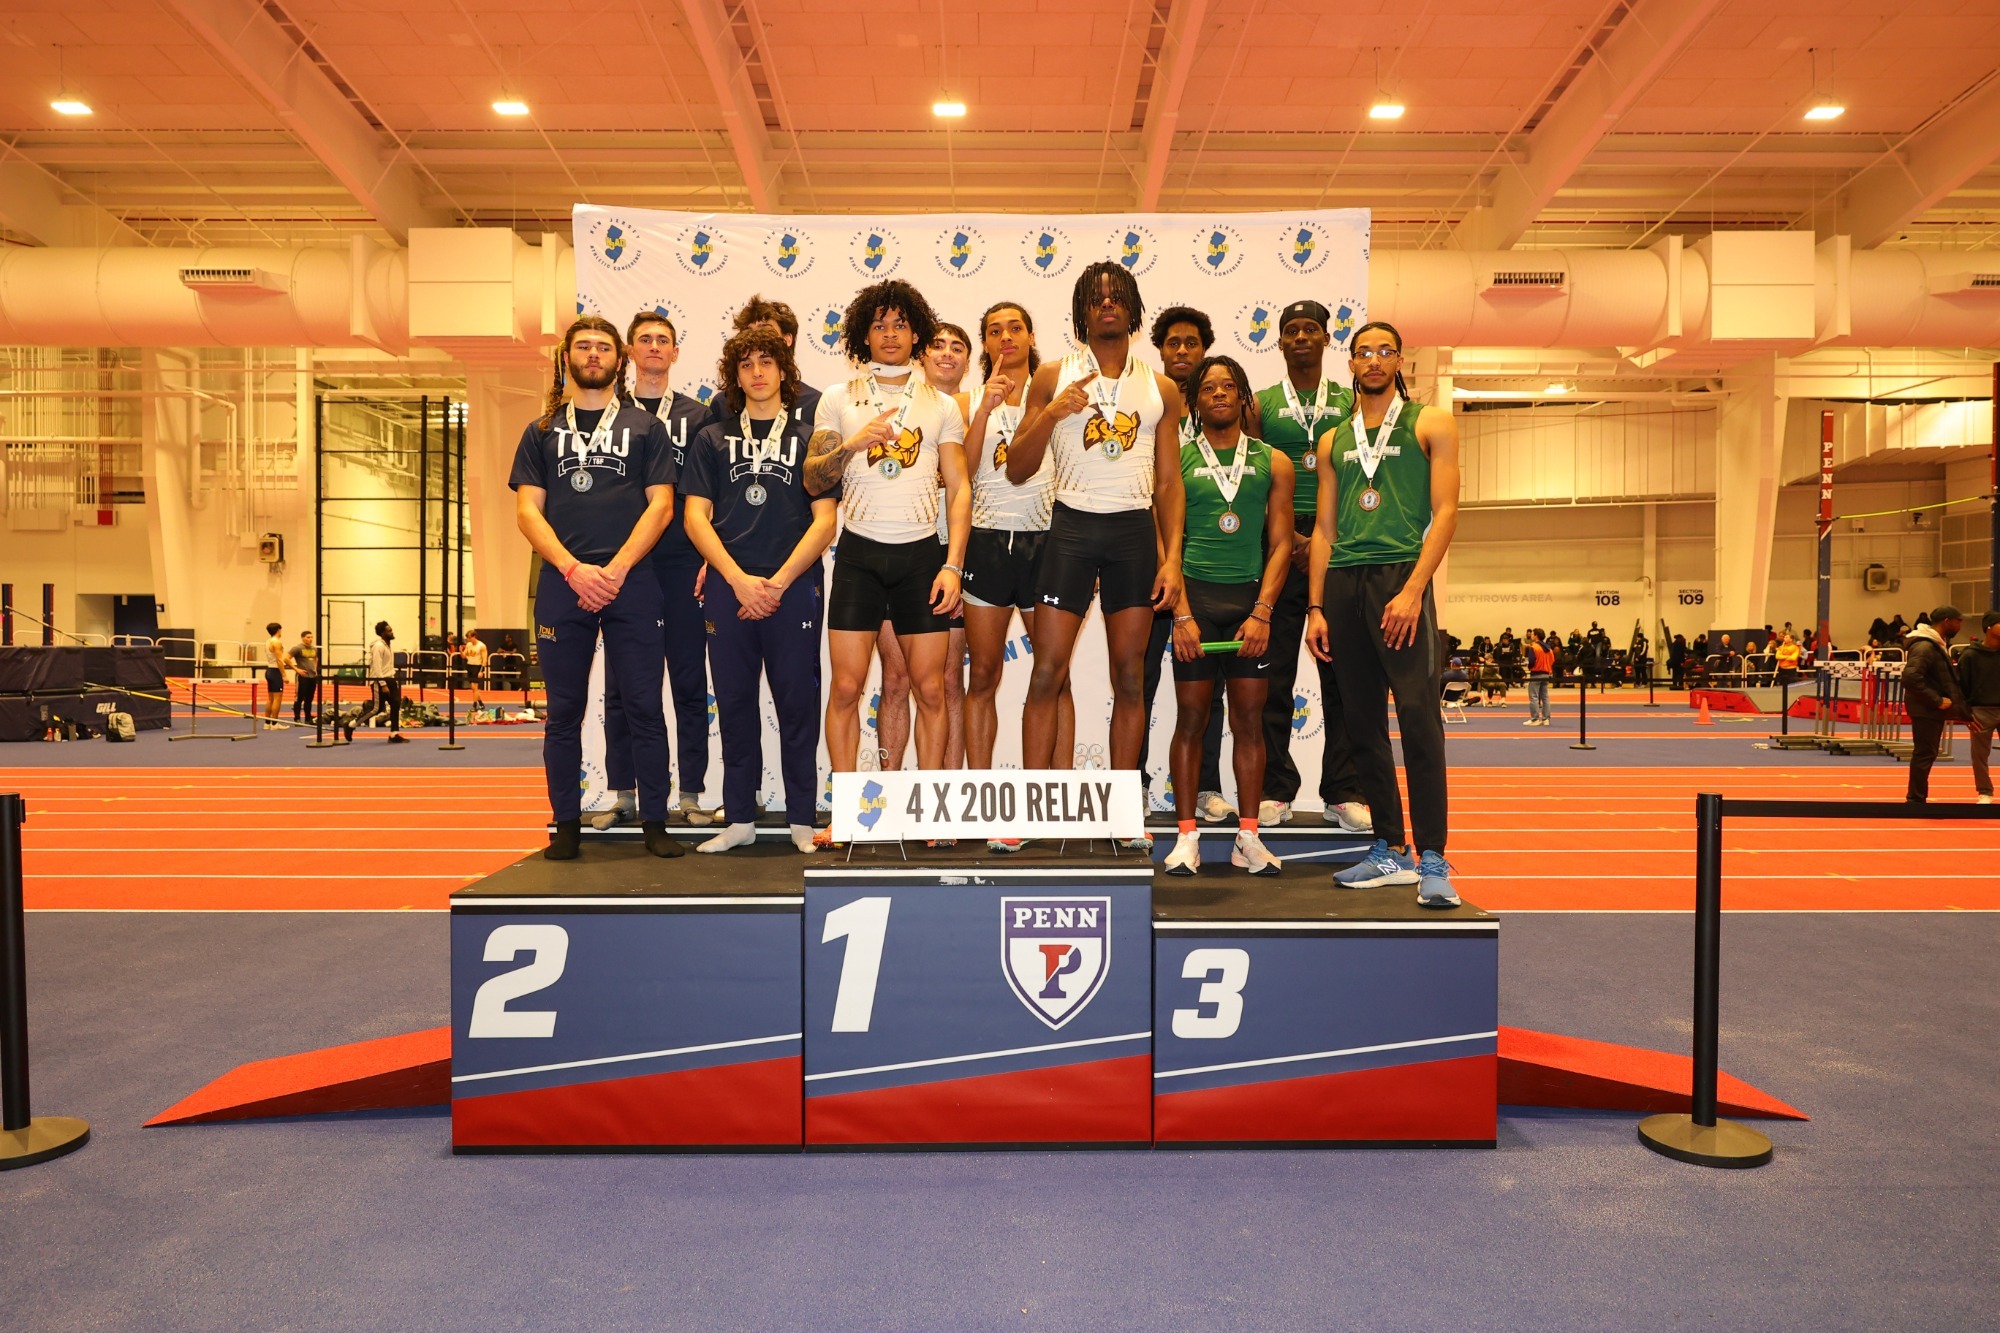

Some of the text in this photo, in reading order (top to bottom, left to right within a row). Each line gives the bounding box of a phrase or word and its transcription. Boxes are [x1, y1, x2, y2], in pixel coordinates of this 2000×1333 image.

[1822, 442, 1833, 499] PENN
[1468, 594, 1518, 603] THROWS
[1521, 594, 1552, 602] AREA
[1595, 596, 1620, 606] 108
[1678, 594, 1704, 605] 109
[96, 702, 117, 714] GILL
[859, 796, 887, 814] NJAC
[906, 782, 1112, 822] 4 X 200 RELAY
[1013, 908, 1100, 928] PENN
[821, 897, 892, 1033] 1
[1039, 944, 1082, 998] P
[468, 924, 568, 1039] 2
[1172, 948, 1250, 1039] 3
